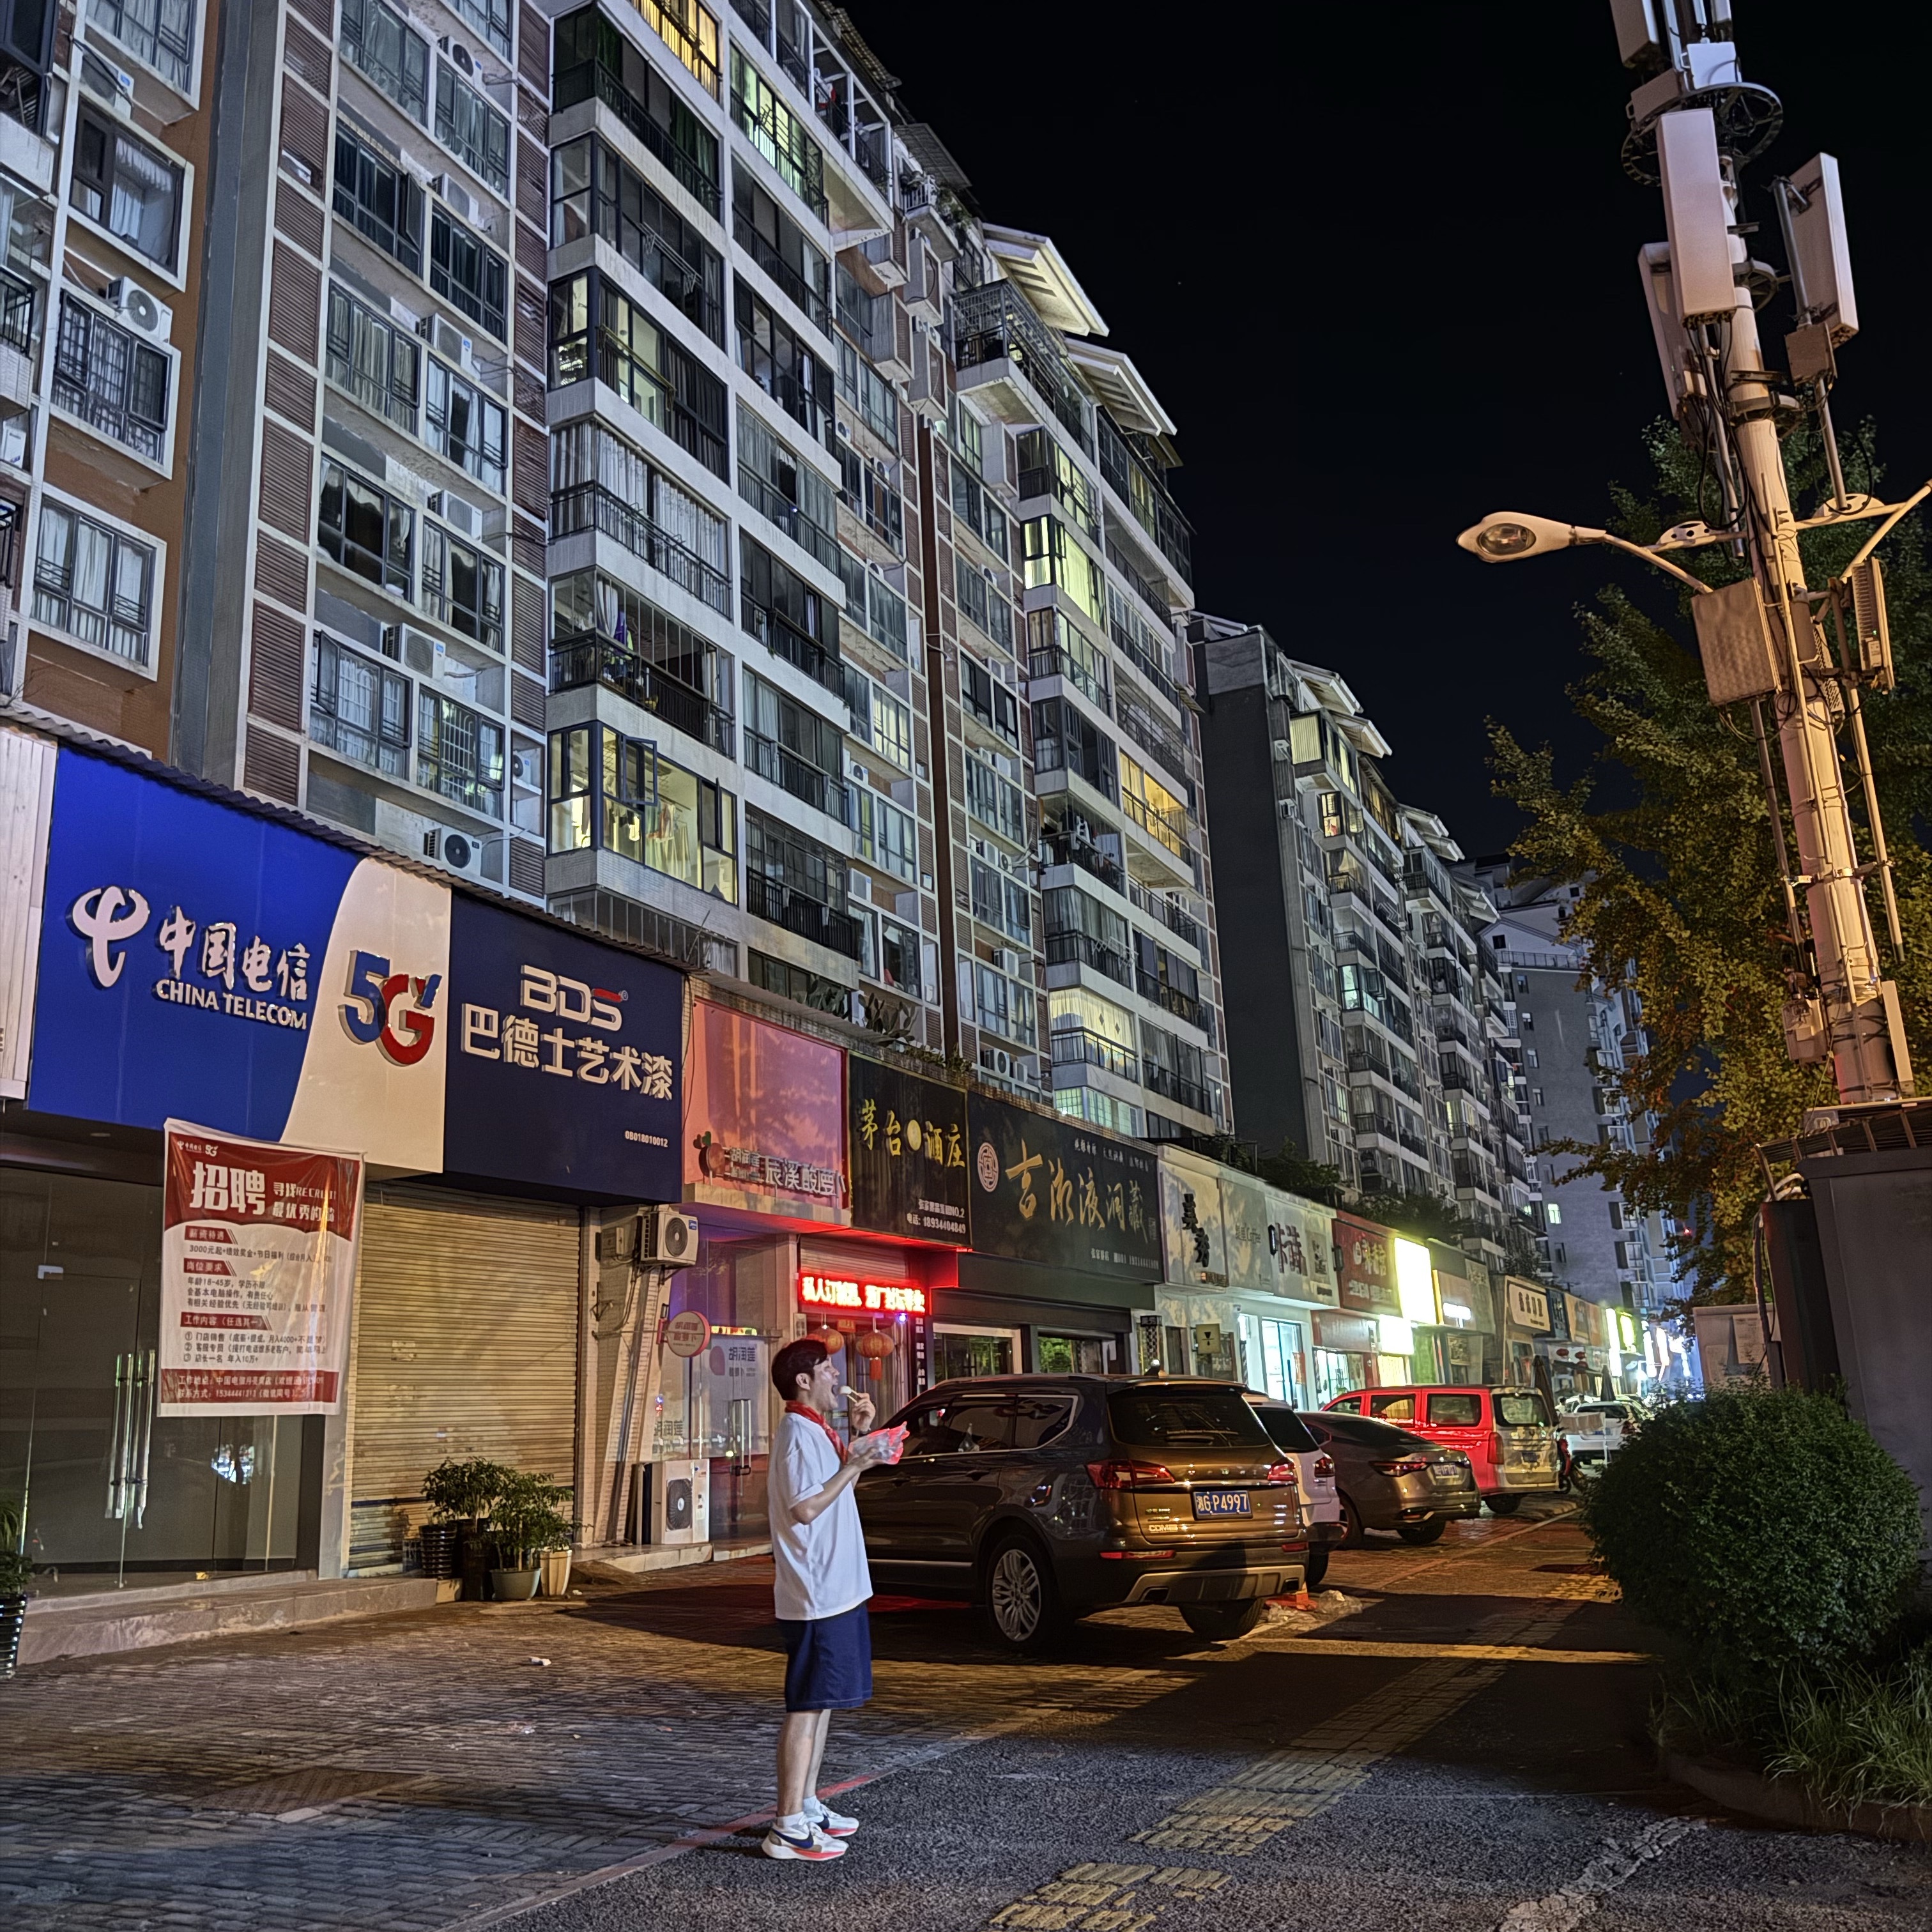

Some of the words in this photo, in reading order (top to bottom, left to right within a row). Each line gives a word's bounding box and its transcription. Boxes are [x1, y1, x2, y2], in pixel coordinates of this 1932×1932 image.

[159, 905, 310, 1001] 中国电信
[155, 979, 219, 1011] CHINA
[222, 992, 307, 1030] TELECOM
[339, 949, 442, 1066] 5G
[520, 964, 623, 1031] BDS
[461, 1002, 673, 1100] 巴德士艺术漆
[189, 1161, 266, 1215] 招聘
[187, 1261, 222, 1272] 岗位要求
